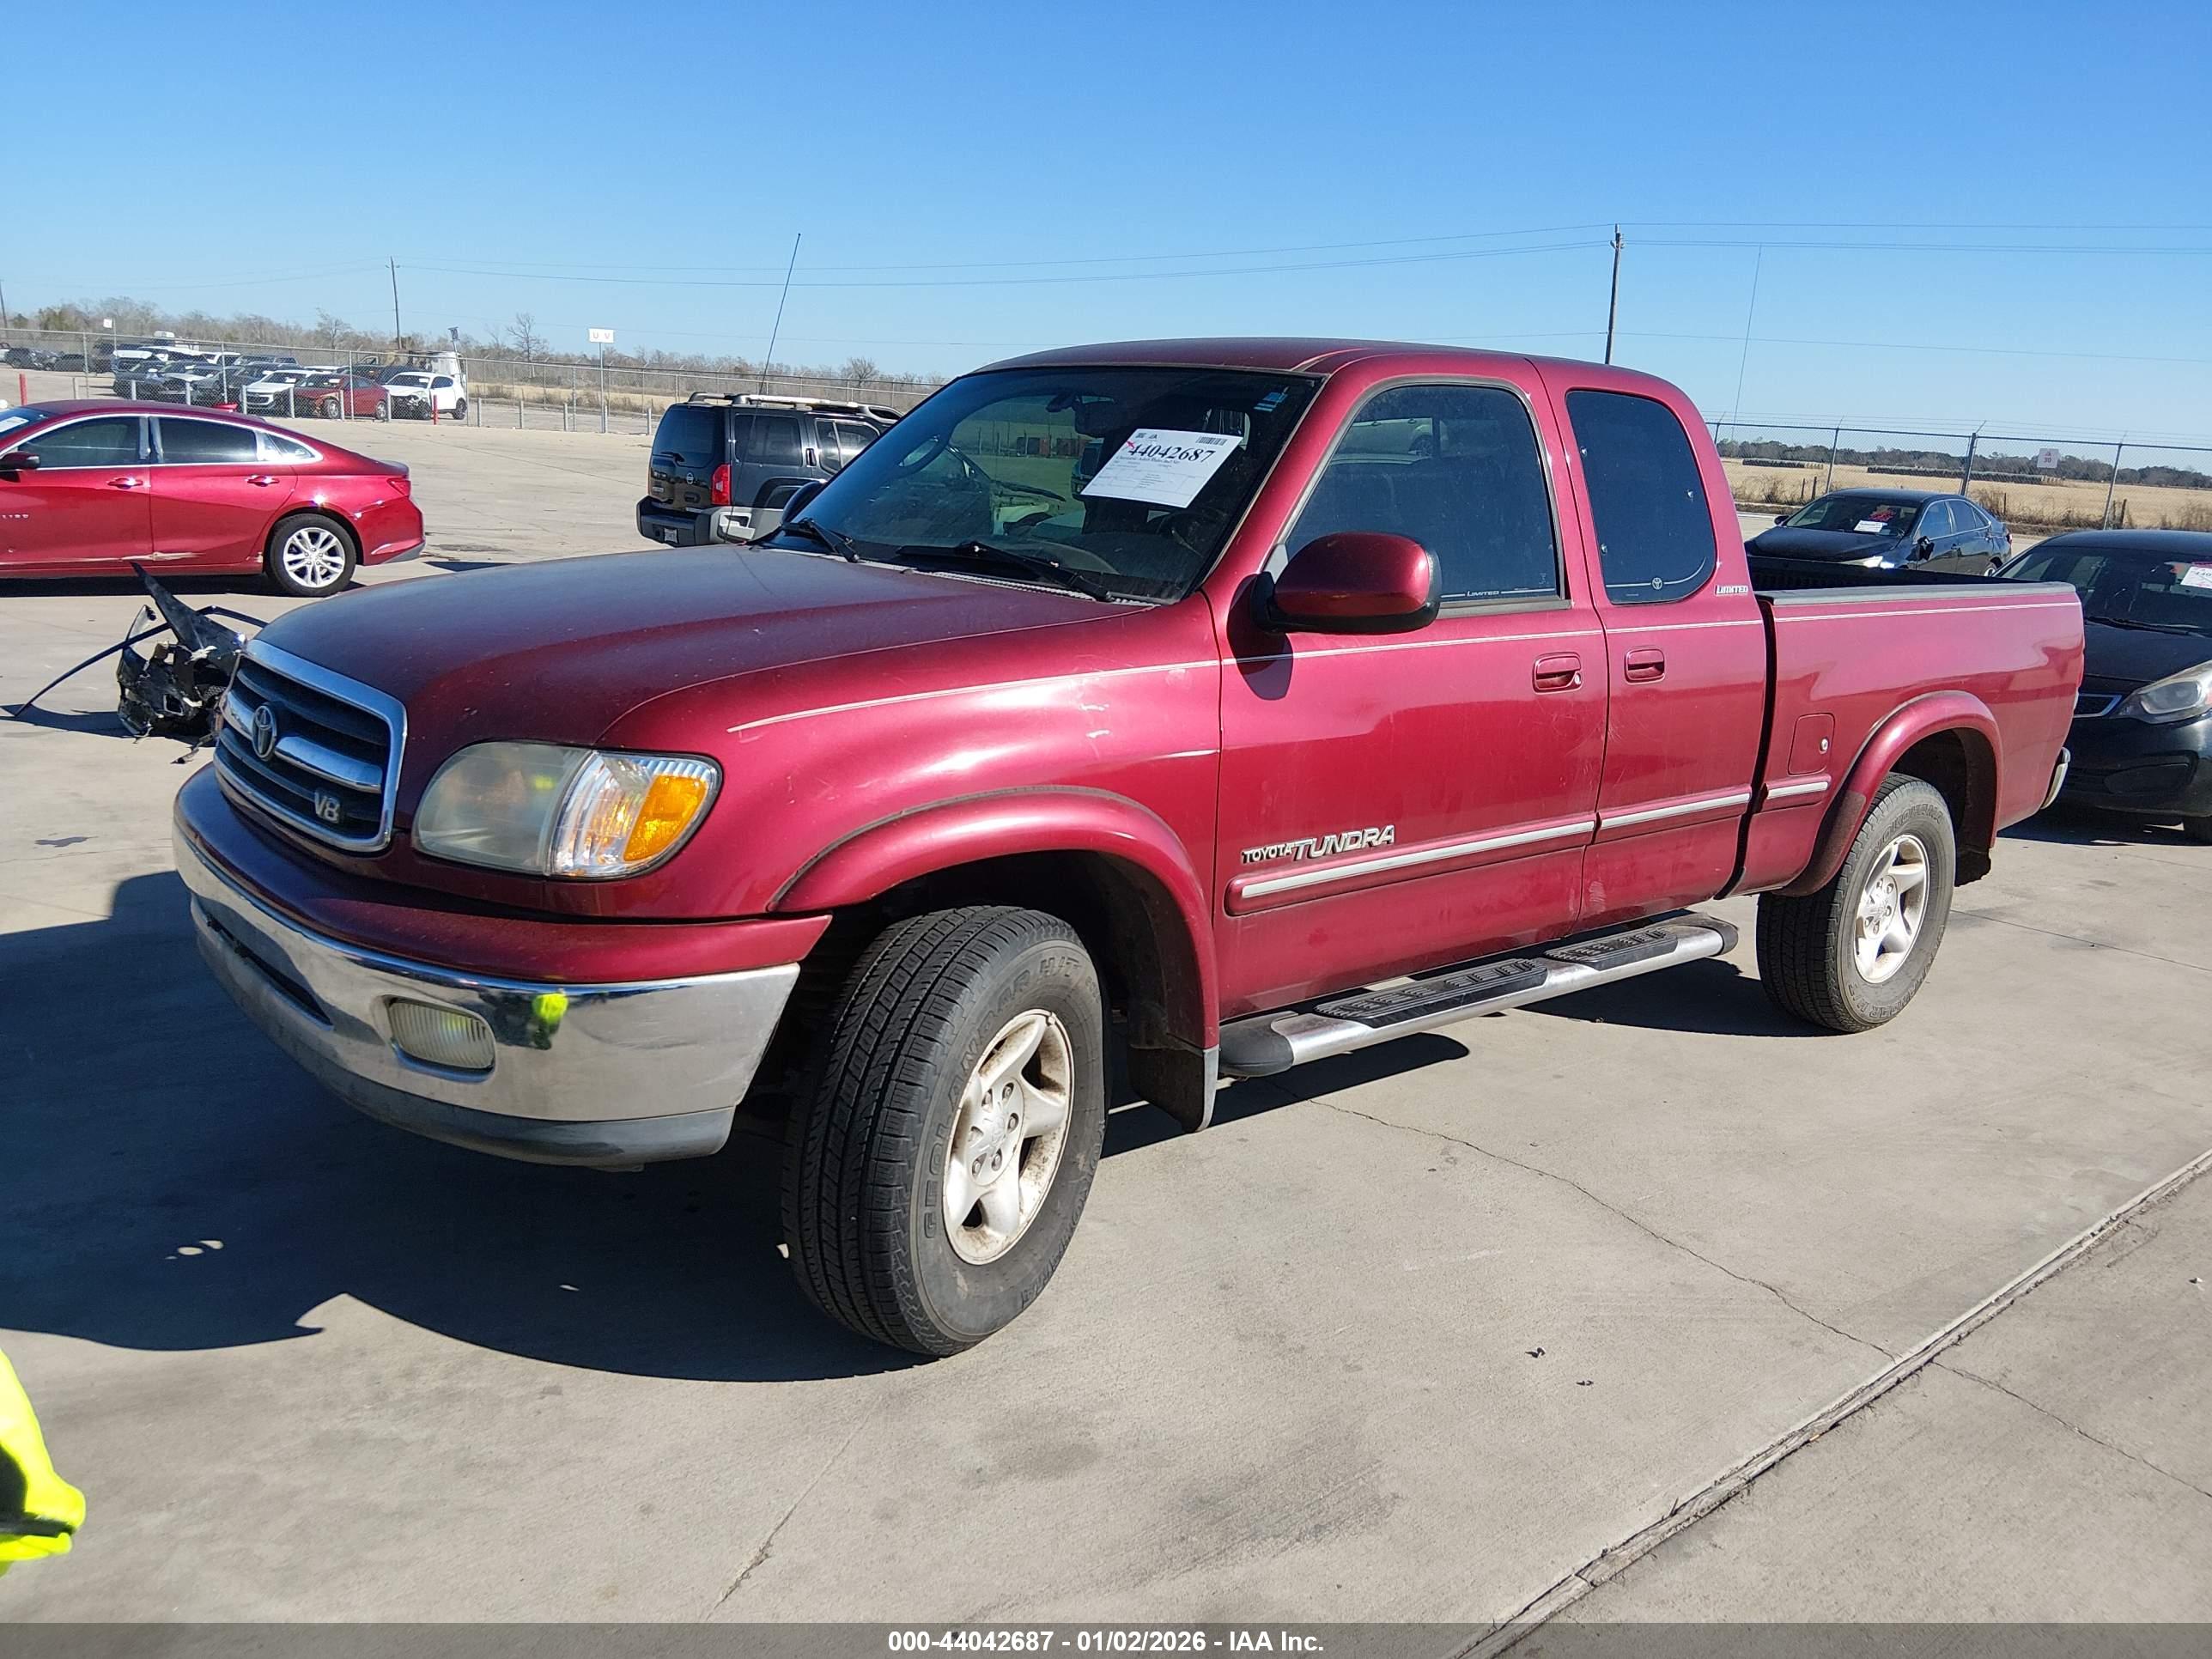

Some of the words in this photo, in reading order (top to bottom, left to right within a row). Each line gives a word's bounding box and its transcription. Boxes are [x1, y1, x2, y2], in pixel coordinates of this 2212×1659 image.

[1127, 443, 1217, 463] 44042687
[1716, 584, 1749, 595] LIMITED
[313, 791, 342, 824] V8
[1243, 842, 1294, 864] TOYOTA
[1291, 824, 1395, 861] TUNDRA
[1038, 955, 1082, 980] H/T
